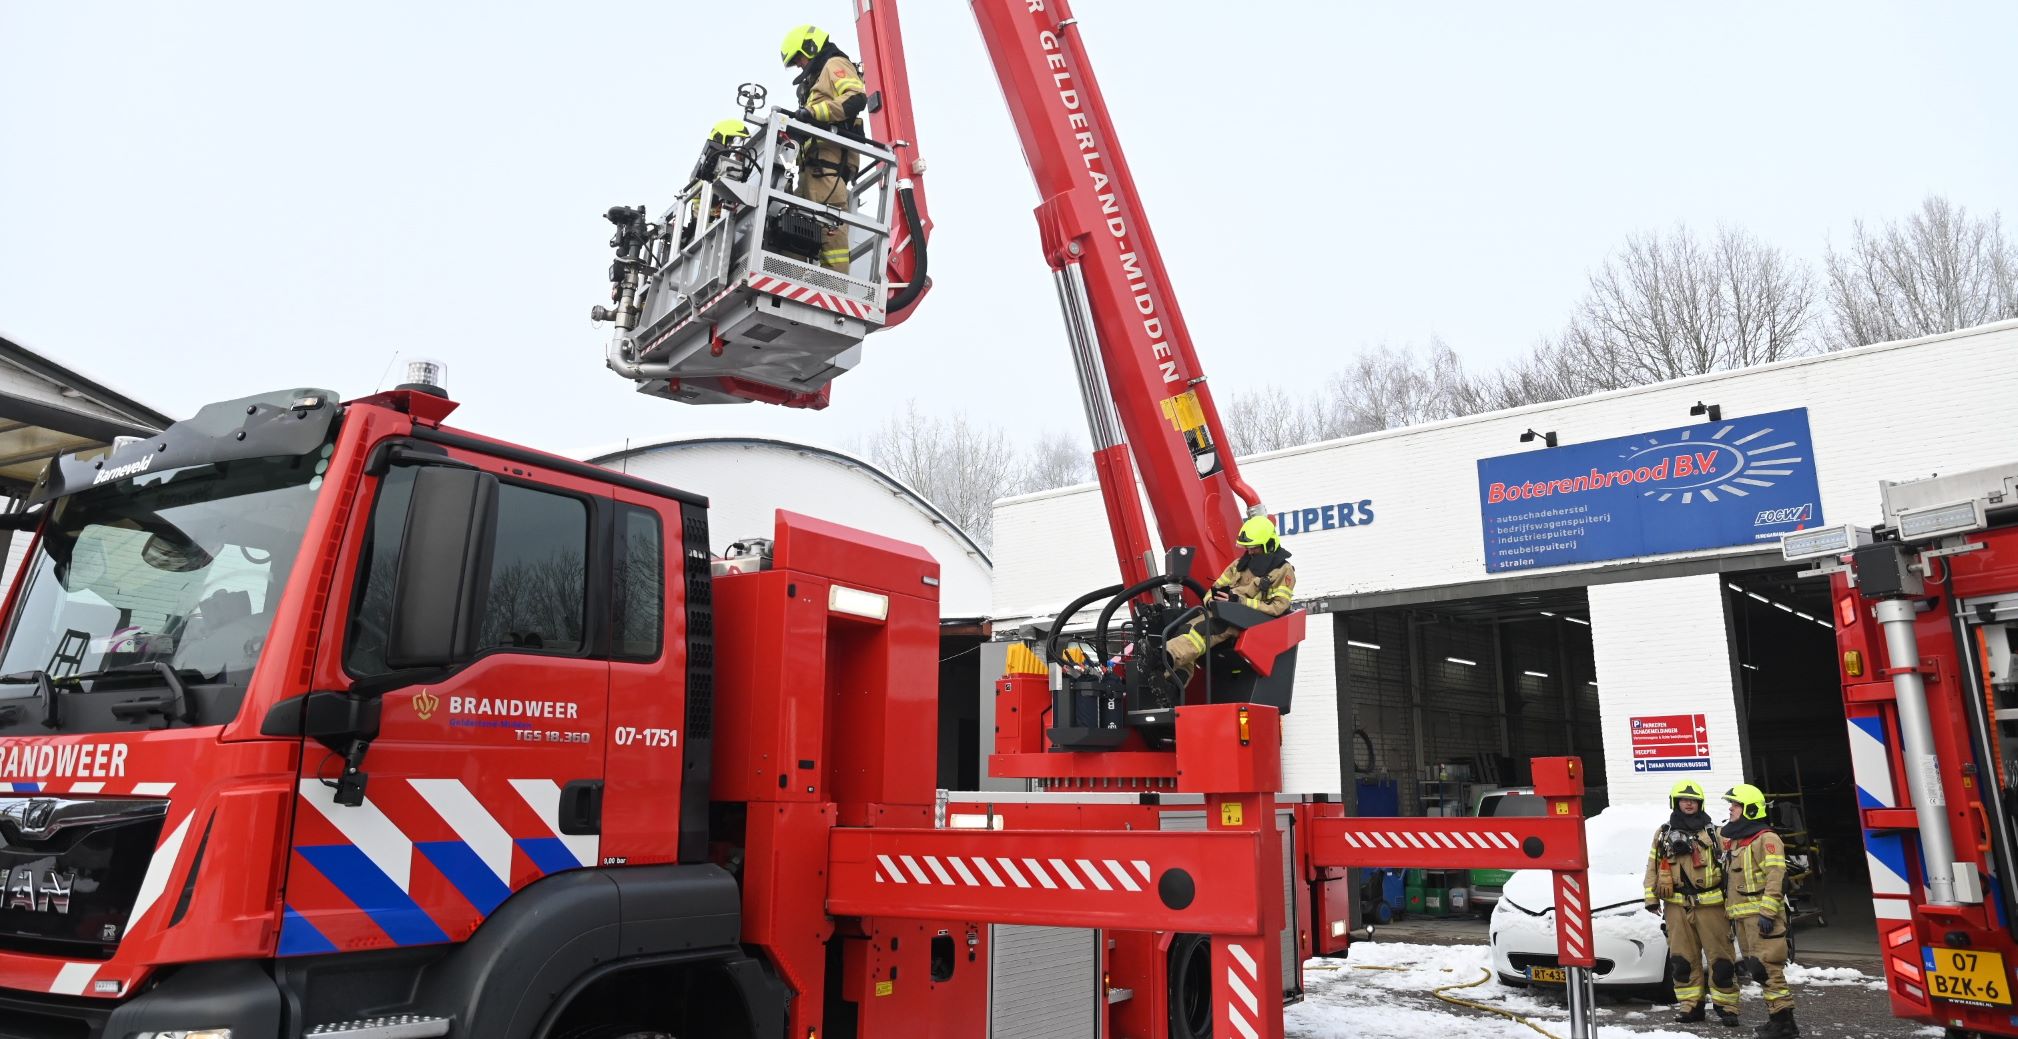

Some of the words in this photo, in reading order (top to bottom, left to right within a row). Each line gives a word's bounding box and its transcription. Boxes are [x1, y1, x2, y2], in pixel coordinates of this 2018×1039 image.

[1039, 30, 1180, 384] GELDERLAND-MIDDEN
[93, 454, 154, 485] Barneveld
[1487, 458, 1668, 504] Boterenbrood
[1673, 450, 1719, 479] B.V.
[1278, 499, 1374, 536] IJPERS
[1496, 505, 1588, 523] autoschadeherstel
[1497, 513, 1611, 534] bedrijfswagenspuiterij
[1755, 503, 1812, 524] FOCWA
[1498, 527, 1585, 544] industriespuiterij
[1498, 541, 1577, 556] meubelspuiterij
[1500, 558, 1535, 568] stralen
[449, 696, 578, 719] BRANDWEER
[514, 729, 542, 741] TGS
[544, 731, 591, 744] 18.360
[614, 726, 678, 747] 07-1751
[0, 743, 128, 778] ANDWEER
[0, 868, 75, 914] AN
[1952, 953, 1977, 972] 07
[1534, 969, 1566, 980] RT-433
[1935, 975, 1998, 999] BZK-6
